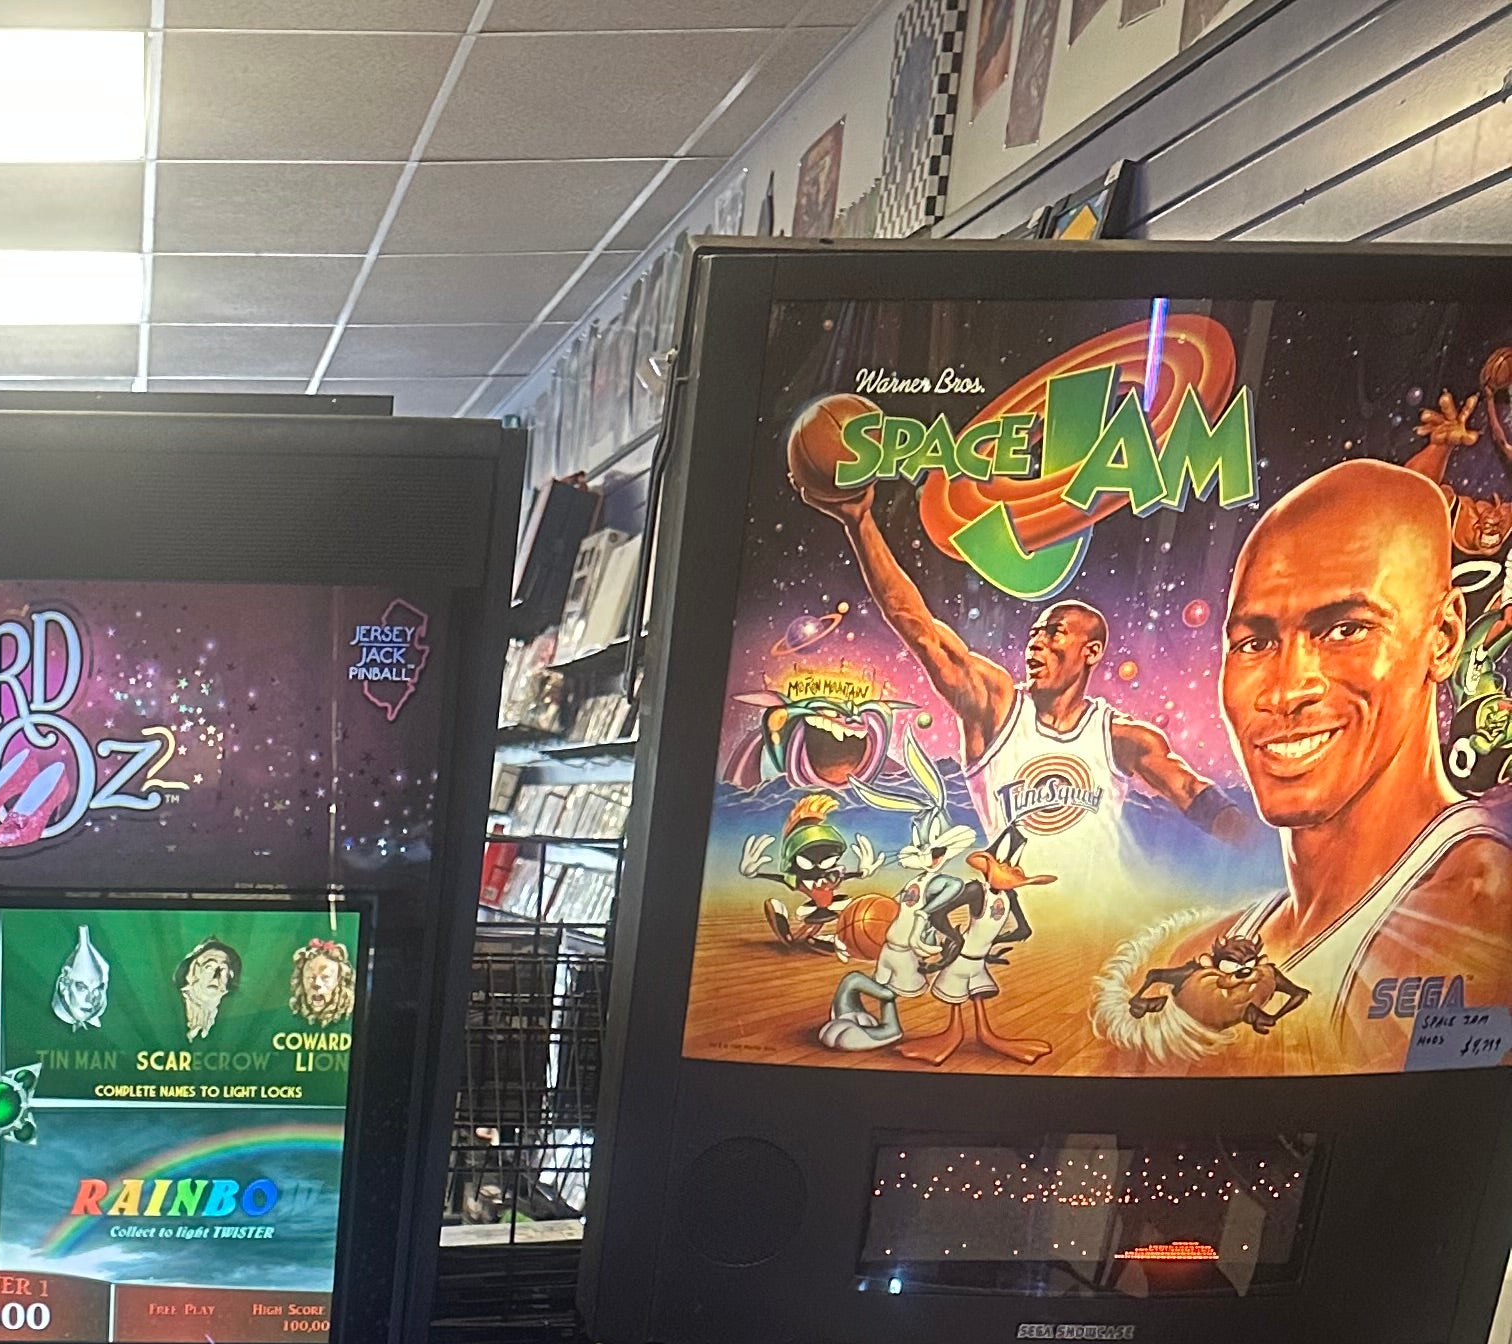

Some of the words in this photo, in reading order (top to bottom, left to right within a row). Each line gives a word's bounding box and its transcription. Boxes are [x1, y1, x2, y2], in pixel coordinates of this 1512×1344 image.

[855, 368, 932, 393] Warner
[934, 369, 986, 394] Bros.
[835, 411, 1039, 488] SPACE
[948, 363, 1257, 600] JAM
[350, 625, 416, 645] JERSEY
[356, 647, 407, 667] JACK
[349, 666, 411, 681] PINBALL
[1367, 974, 1465, 1020] SEGA
[75, 1050, 118, 1071] MAN
[137, 1050, 270, 1072] SCARECROW
[94, 1084, 157, 1098] COMPLETE
[159, 1085, 196, 1098] NAMES
[200, 1085, 221, 1098] TO
[223, 1085, 259, 1099] LIGHT
[260, 1085, 303, 1099] LOCKS
[110, 1225, 156, 1239] Collect
[158, 1226, 174, 1239] to
[176, 1226, 209, 1240] light
[212, 1226, 275, 1239] TWISTER
[40, 1279, 49, 1297] 1
[149, 1303, 177, 1316] FREE
[184, 1303, 216, 1317] PLAY
[252, 1303, 283, 1316] HIGH
[288, 1303, 326, 1317] SCORE
[1017, 1323, 1054, 1339] SEGA
[1055, 1323, 1136, 1340] SHOWCASE
